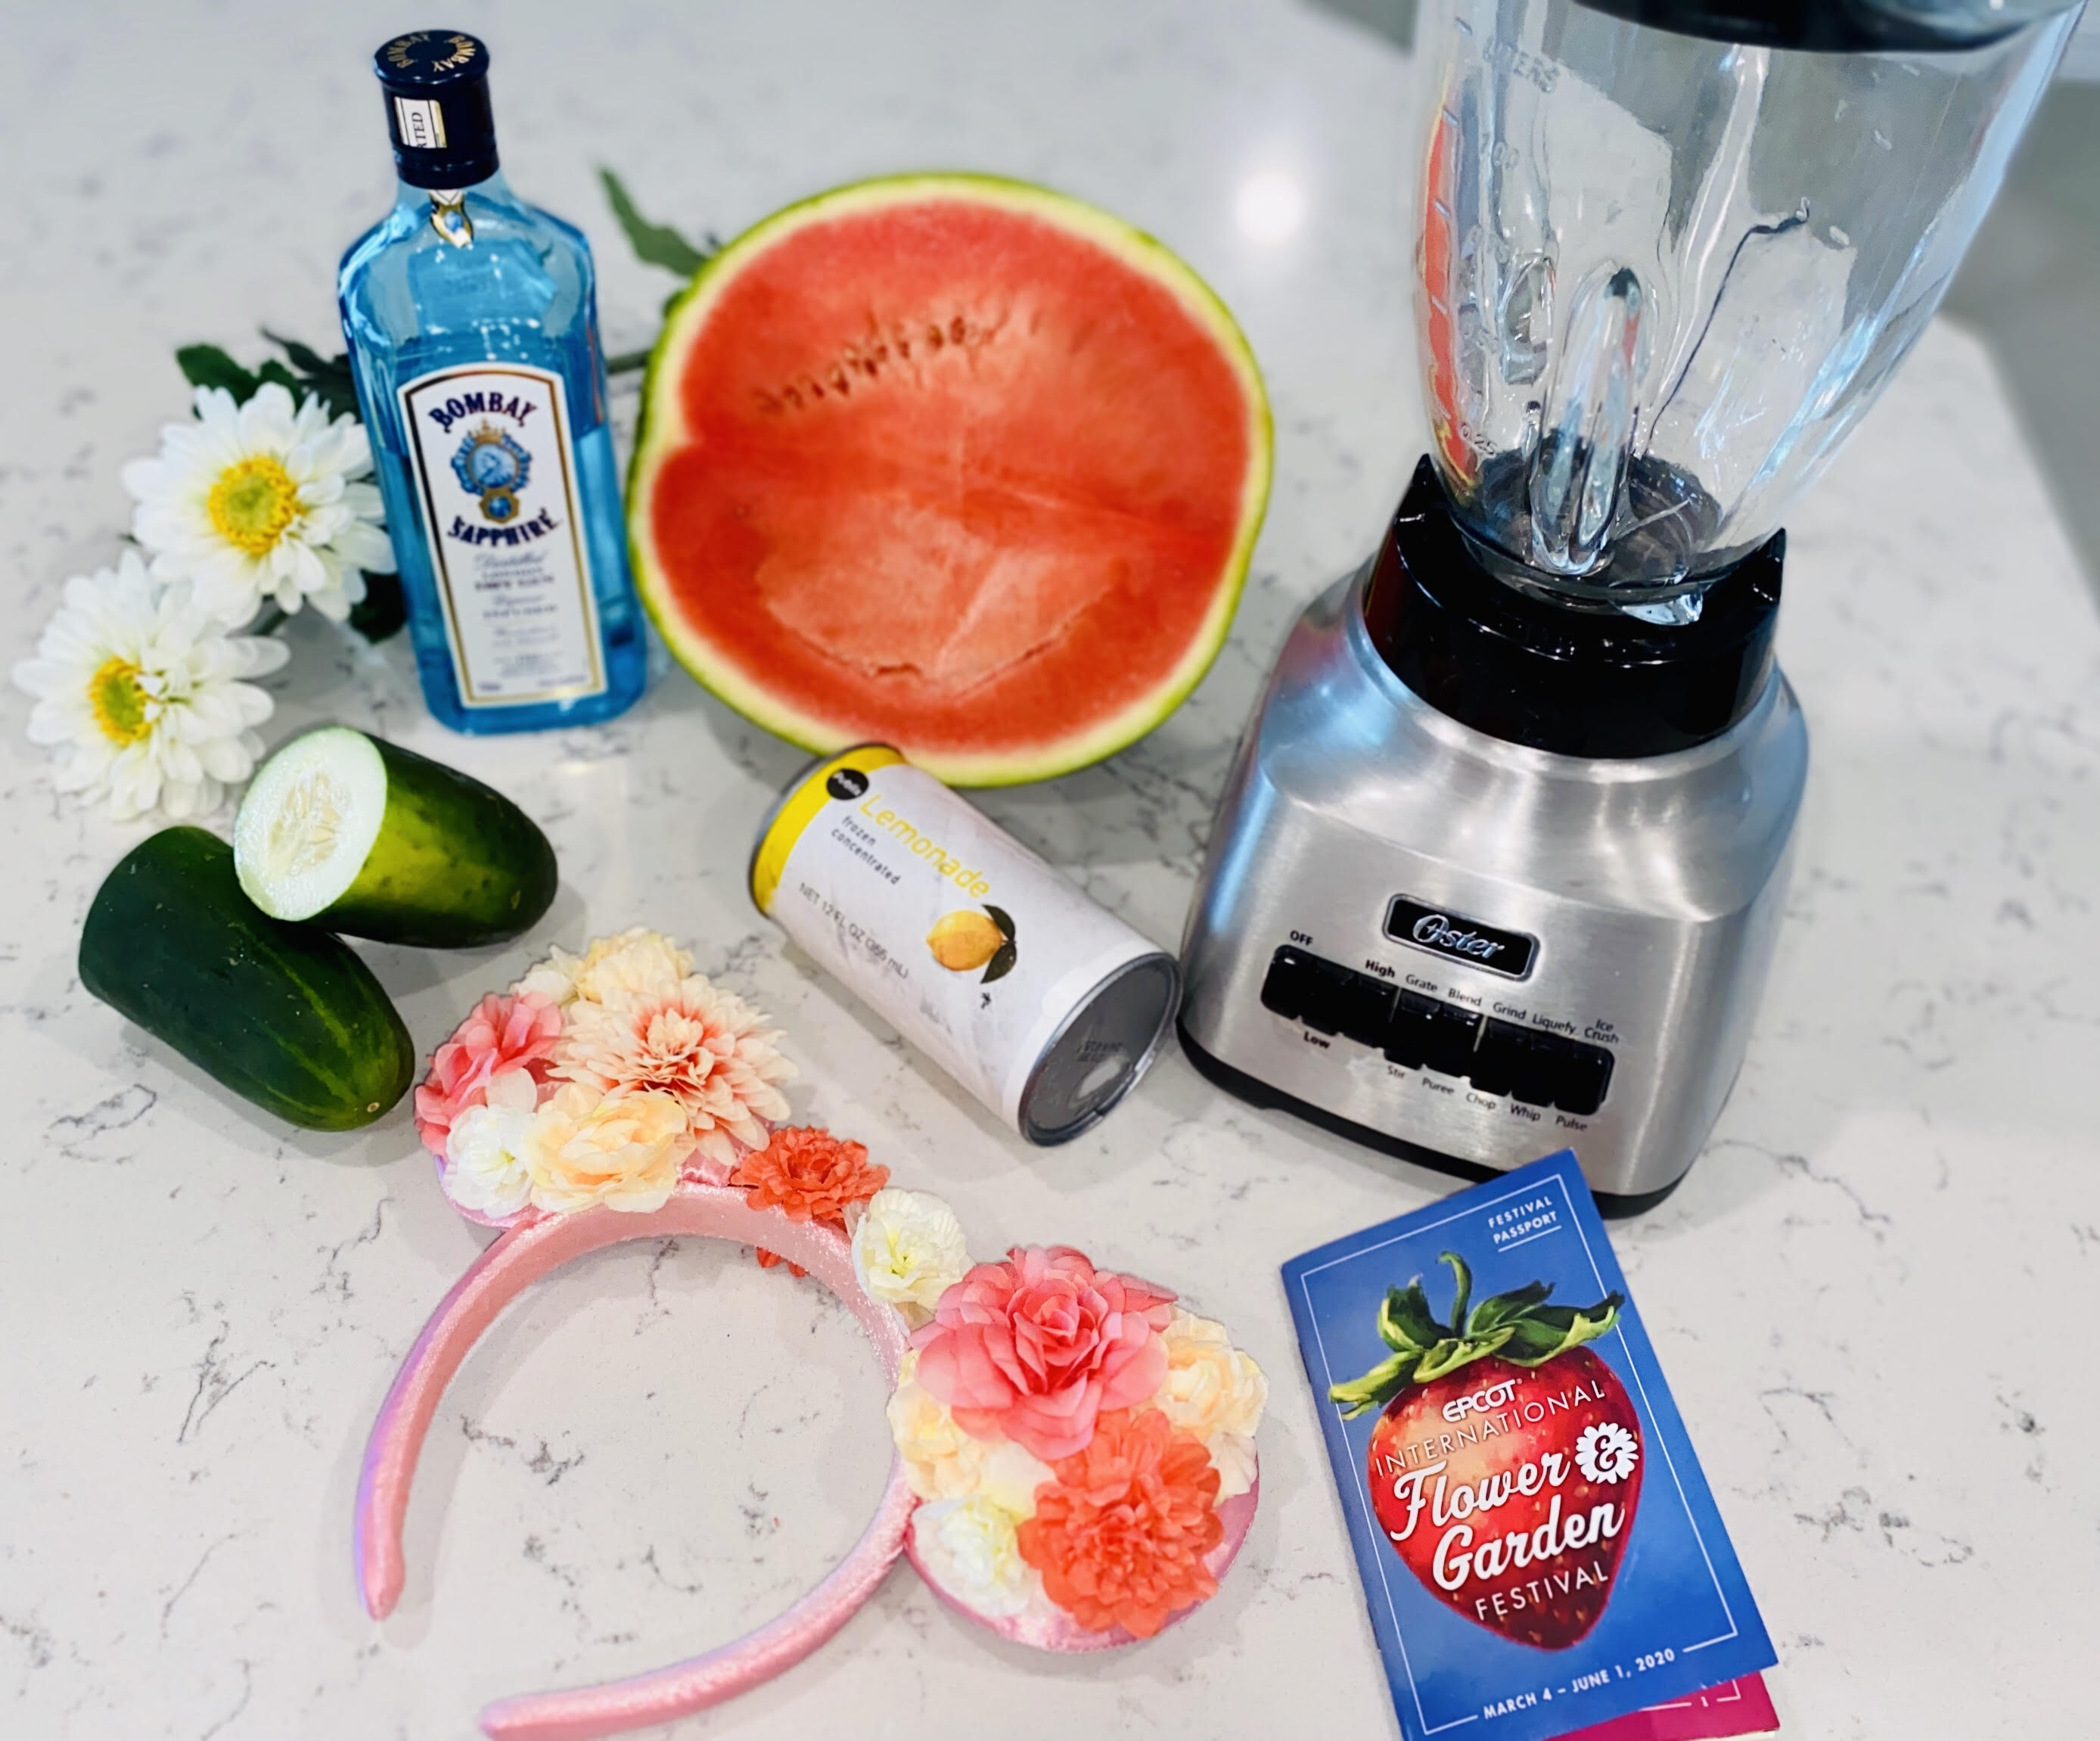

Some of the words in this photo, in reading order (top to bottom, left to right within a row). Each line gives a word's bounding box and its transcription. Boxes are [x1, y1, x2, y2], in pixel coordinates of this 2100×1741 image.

[428, 392, 536, 434] BOMBAY
[447, 507, 561, 547] SAPPHIRE
[842, 816, 876, 846] frozen
[860, 793, 989, 898] Lemonade
[831, 829, 902, 885] concentrated
[799, 882, 820, 904] NET
[822, 901, 834, 916] 12
[834, 911, 845, 929] FL
[849, 923, 865, 943] OZ
[1412, 914, 1505, 959] Oster
[1290, 931, 1313, 947] OFF
[1365, 959, 1396, 978] High
[1406, 974, 1438, 992] Grate
[1448, 988, 1482, 1007] Blend
[1493, 1002, 1527, 1020] Grind
[1532, 1013, 1577, 1035] Liquefy
[1303, 1031, 1331, 1049] Low
[1584, 1028, 1620, 1044] Crush
[1595, 1019, 1614, 1032] Ice
[1387, 1065, 1406, 1079] Stir
[1422, 1077, 1455, 1095] Puree
[1465, 1092, 1496, 1111] Chop
[1510, 1104, 1541, 1122] Whip
[1555, 1115, 1588, 1132] Pulse
[1488, 1195, 1553, 1228] FESTIVAL
[1493, 1211, 1558, 1245] PASSPORT
[1375, 1379, 1606, 1477] INTERNATIONAL
[1390, 1450, 1573, 1541] Flower
[1593, 1435, 1625, 1473] &
[1432, 1494, 1626, 1591] Garden
[1475, 1560, 1609, 1621] FESTIVAL
[1483, 1691, 1537, 1720] MARCH
[1542, 1687, 1553, 1702] 4
[1571, 1669, 1611, 1693] JUNE
[1614, 1665, 1632, 1680] 1,
[1635, 1648, 1676, 1672] 2020
